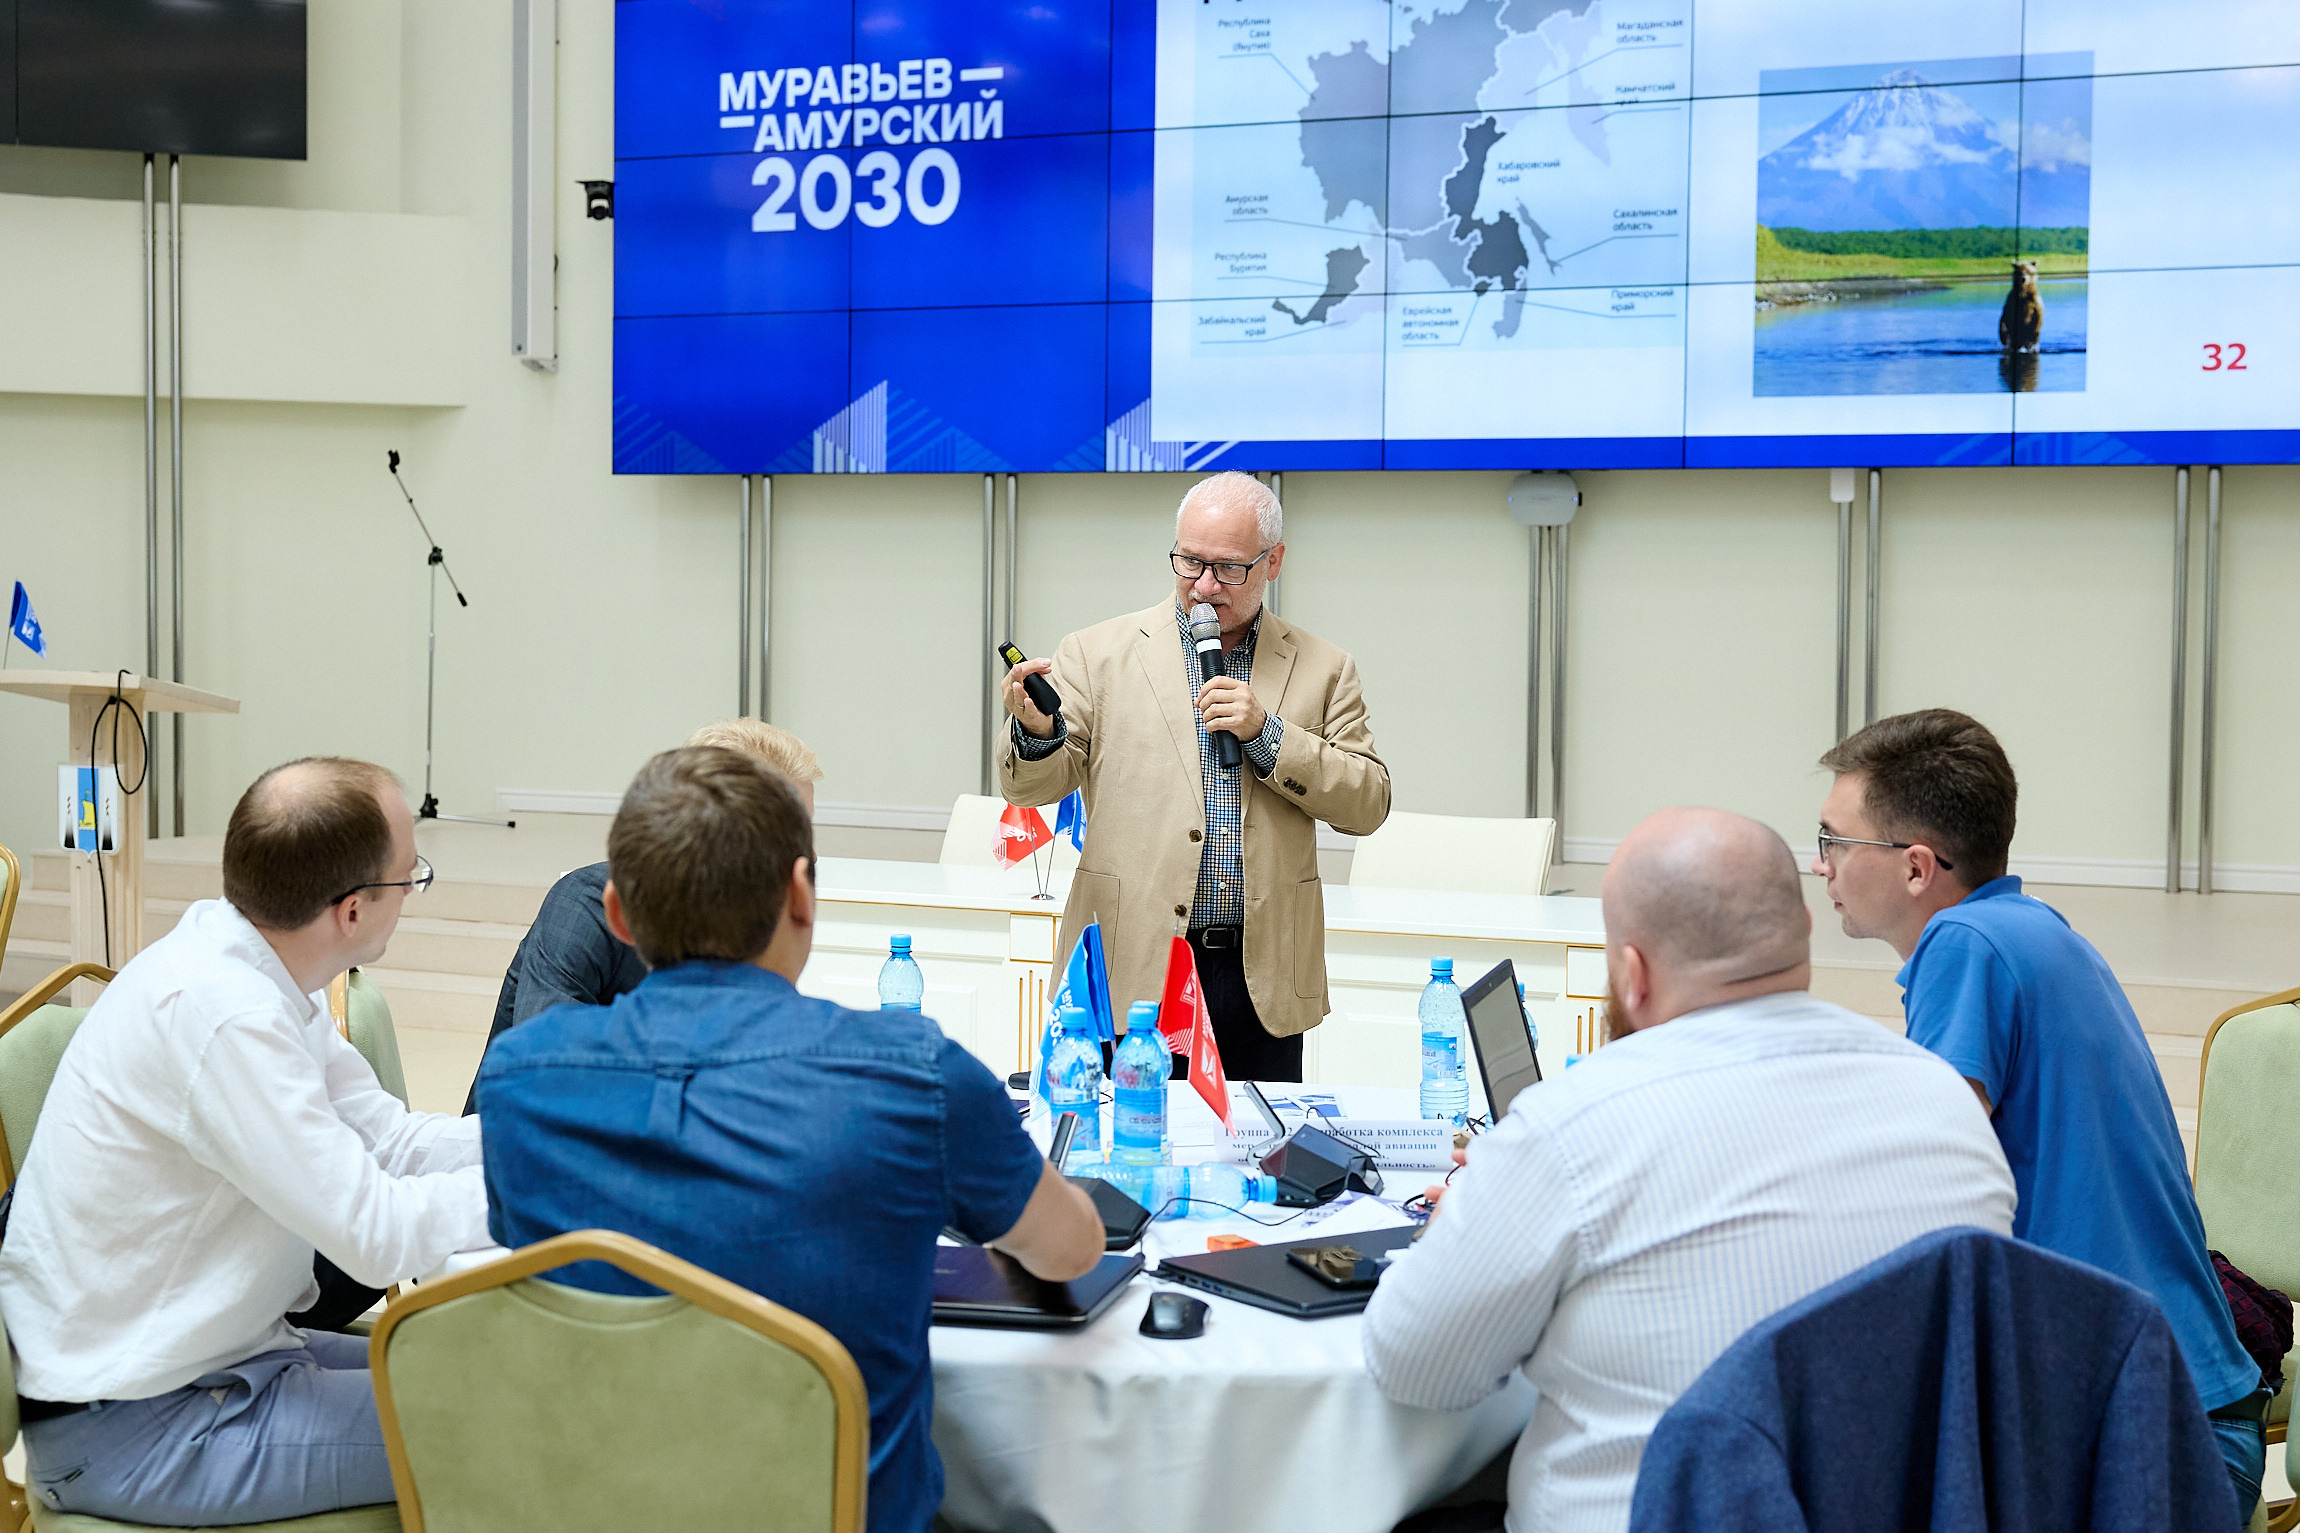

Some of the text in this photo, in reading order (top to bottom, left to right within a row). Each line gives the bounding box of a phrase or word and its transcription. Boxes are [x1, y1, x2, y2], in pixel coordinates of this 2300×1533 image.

[1217, 18, 1271, 29] Республика
[1616, 20, 1684, 31] Магаданская
[1616, 34, 1656, 43] область
[1498, 158, 1560, 171] Хабаровский
[1497, 174, 1519, 184] край
[751, 147, 962, 233] 2030
[1232, 206, 1268, 216] область
[1613, 208, 1678, 220] Сахалинская
[1612, 221, 1653, 232] область
[1214, 252, 1267, 263] Республика
[1611, 287, 1674, 300] Приморский
[1611, 302, 1635, 312] край
[1401, 331, 1440, 341] область
[2202, 343, 2247, 371] 32
[1377, 1128, 1443, 1137] комплекса
[1385, 1143, 1437, 1151] авиации
